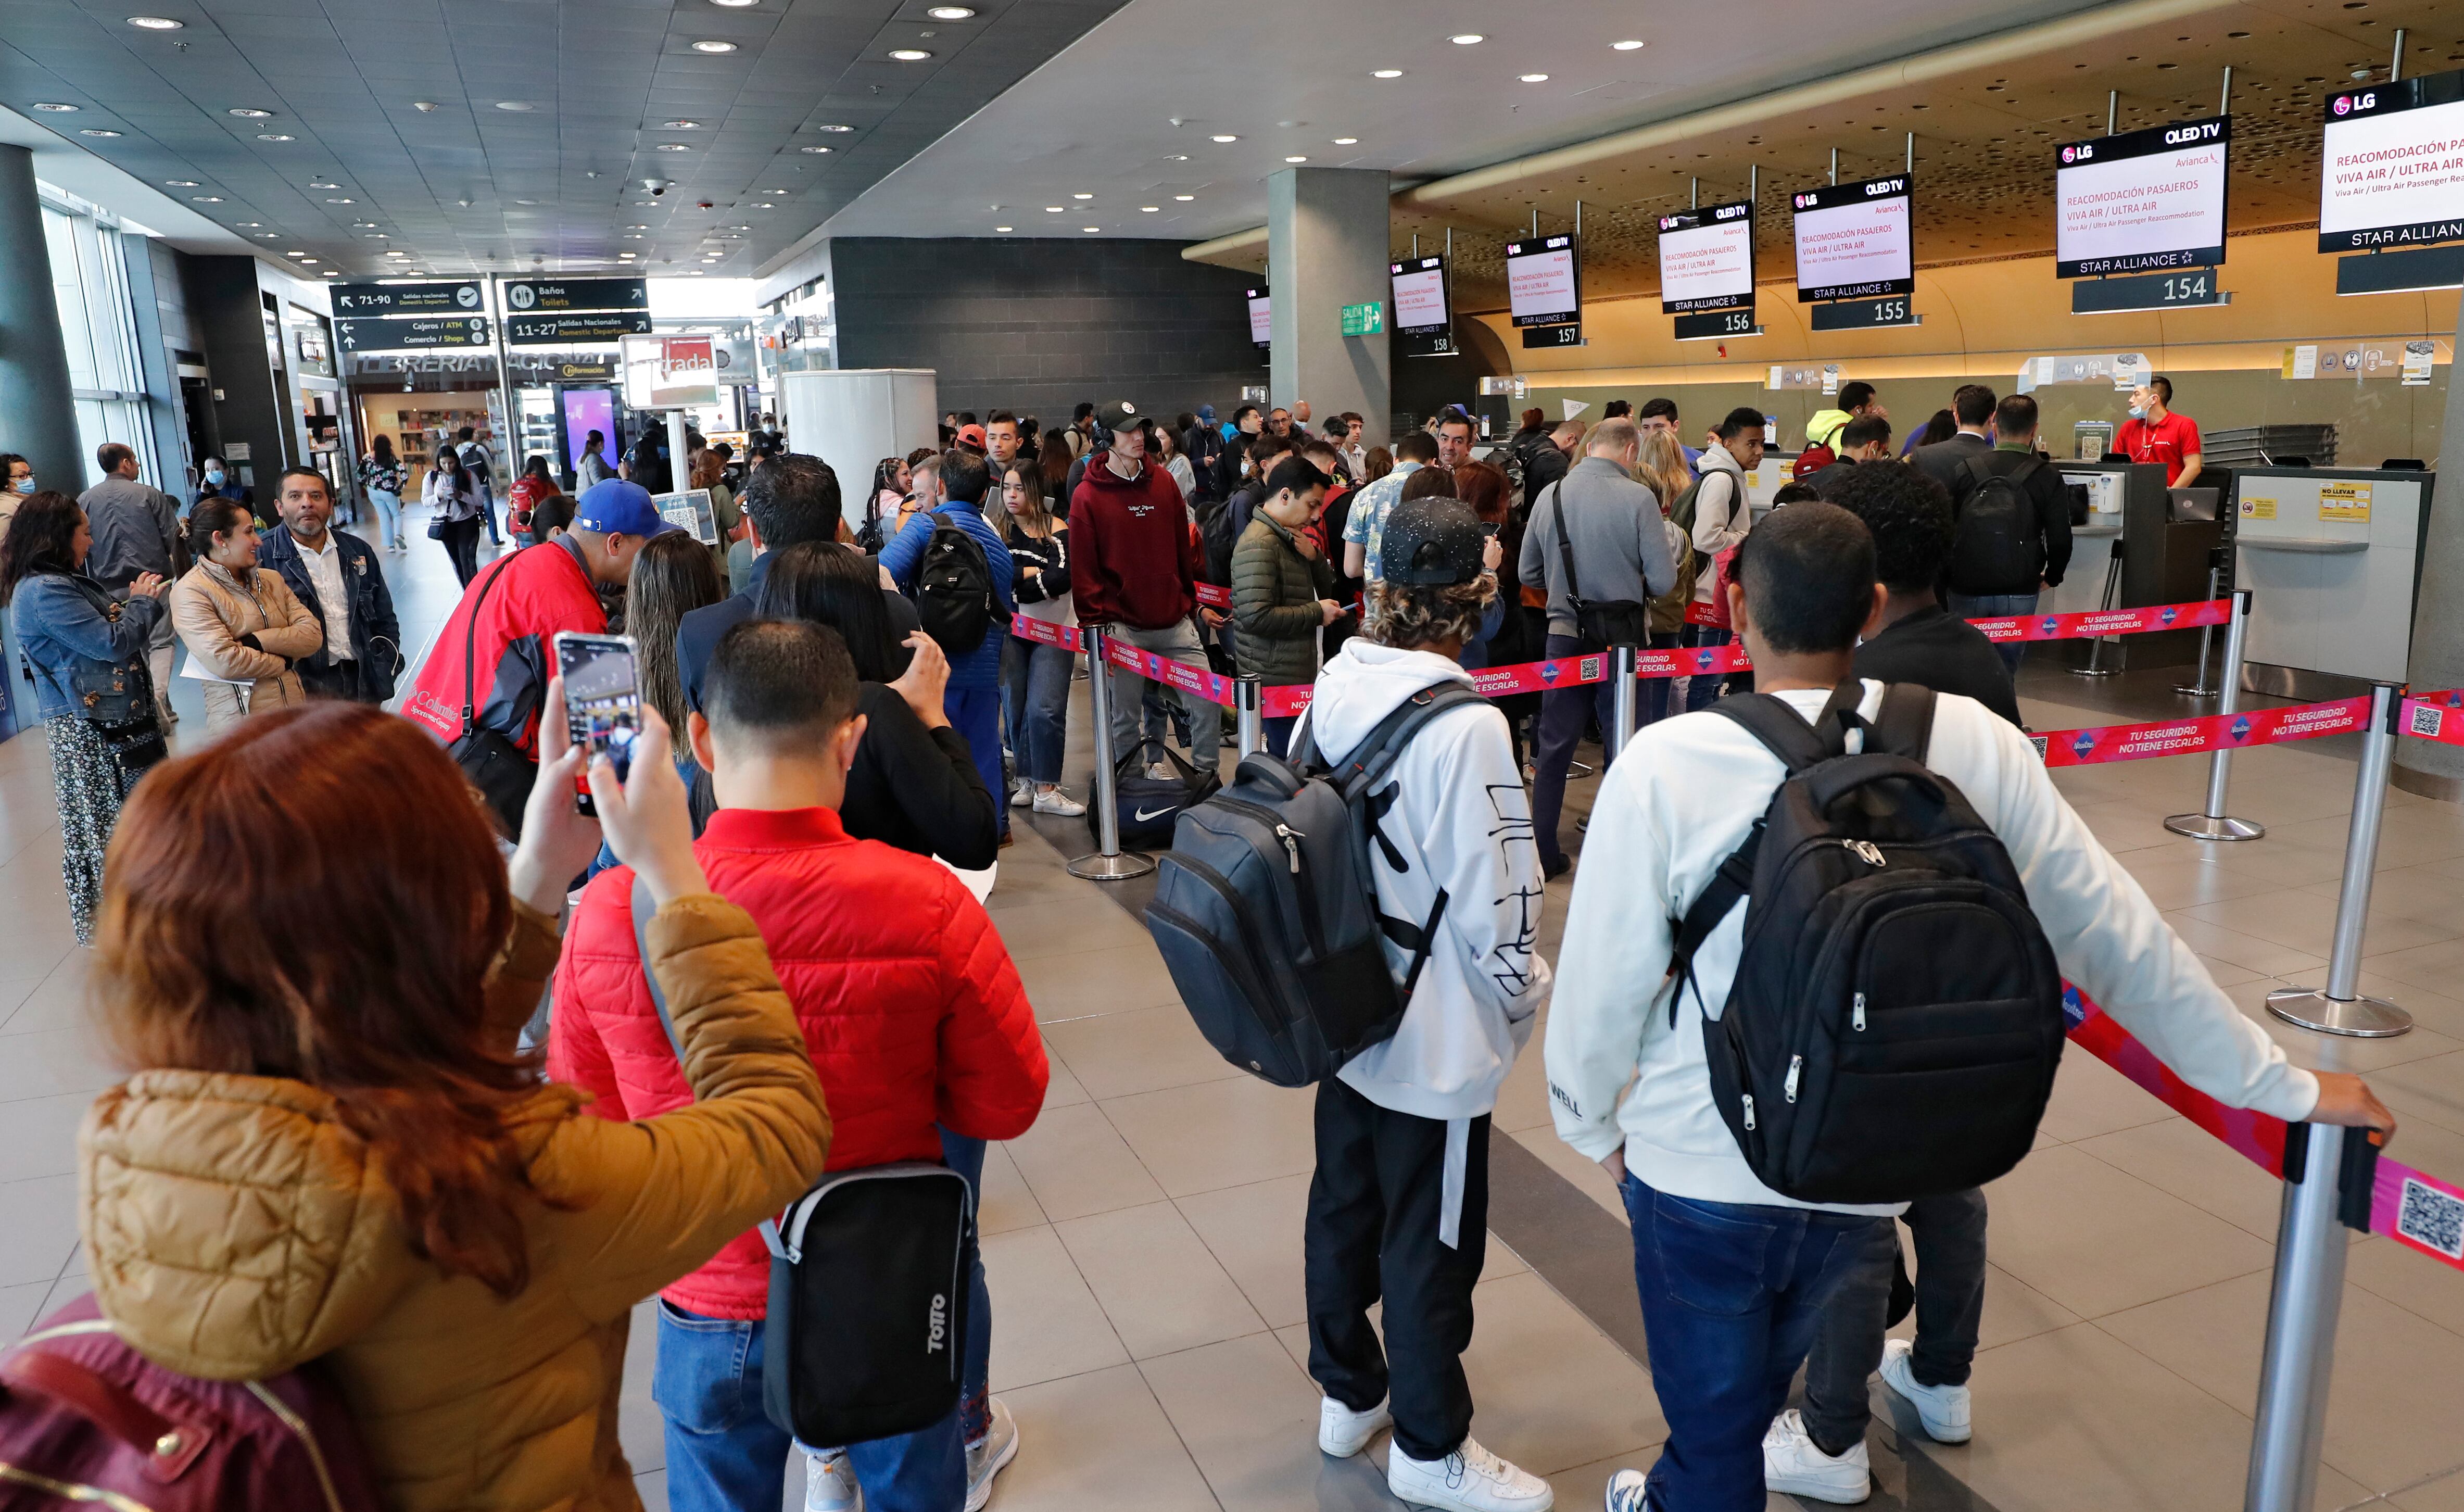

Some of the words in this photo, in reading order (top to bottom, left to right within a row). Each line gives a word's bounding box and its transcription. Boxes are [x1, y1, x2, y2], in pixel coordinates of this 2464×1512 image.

[2354, 93, 2375, 110] LG
[2166, 127, 2200, 144] OLED
[2202, 123, 2220, 137] TV
[2077, 145, 2093, 160] LG
[2337, 140, 2446, 167] REACOMODACIÓN
[2450, 138, 2464, 150] PA
[2176, 155, 2208, 168] Avianca
[2336, 172, 2363, 183] VIVA
[2366, 168, 2386, 180] AIR
[2399, 161, 2438, 176] ULTRA
[2442, 158, 2463, 169] AIR
[1866, 182, 1890, 195] OLED
[1890, 179, 1903, 192] TV
[2372, 184, 2391, 193] Ultra
[2407, 177, 2448, 188] Passenger
[1805, 194, 1817, 206] LG
[2068, 186, 2144, 206] REACOMODACIÓN
[2147, 180, 2198, 195] PASAJEROS
[1716, 207, 1735, 219] OLED
[1735, 205, 1746, 215] TV
[1875, 205, 1898, 215] Avianca
[2067, 210, 2087, 221] VIVA
[2089, 208, 2102, 219] AIR
[2112, 205, 2139, 215] ULTRA
[2142, 201, 2156, 211] AIR
[1668, 217, 1678, 227] LG
[2118, 217, 2146, 226] Passenger
[2148, 210, 2204, 222] Reaccommodation
[1802, 229, 1855, 244] REACOMODACIÓN
[1857, 224, 1892, 237] PASAJEROS
[2352, 230, 2394, 246] STAR
[2399, 222, 2463, 241] ALLIAN
[1513, 245, 1521, 254] LG
[1547, 238, 1561, 248] OLED
[1802, 247, 1816, 255] VIVA
[1834, 243, 1852, 252] ULTRA
[1854, 241, 1865, 249] AIR
[1666, 249, 1708, 260] REACOMODACIÓN
[1709, 245, 1737, 256] PASAJEROS
[2080, 260, 2111, 273] STAR
[2114, 254, 2177, 270] ALLIANCE
[1815, 288, 1835, 298] STAR
[1838, 284, 1881, 296] ALLIANCE
[2165, 277, 2206, 300] 154
[359, 295, 390, 305] 71-90
[1675, 301, 1692, 310] STAR
[1694, 298, 1728, 309] ALLIANCE
[1343, 307, 1362, 319] SALIDA
[1536, 314, 1560, 323] ALLIANCE
[1875, 301, 1903, 321] 155
[413, 323, 438, 332] Cajeros
[516, 323, 557, 336] 11-27
[1725, 314, 1749, 331] 156
[1559, 328, 1575, 342] 157
[1434, 338, 1447, 351] 158
[485, 353, 604, 373] NACIONA
[2095, 613, 2136, 622] SEGURIDAD
[2089, 623, 2109, 631] TIENE
[2111, 621, 2142, 629] ESCALAS
[1636, 655, 1669, 663] GURIDAD
[1176, 667, 1198, 679] SEGURIDAD
[1472, 672, 1511, 683] GURIDAD
[1173, 675, 1184, 685] TIENE
[1185, 679, 1202, 690] ESCALAS
[1482, 680, 1519, 692] ESCALAS
[417, 691, 458, 723] Columbia
[2283, 714, 2296, 723] TU
[2297, 707, 2347, 722] SEGURIDAD
[2130, 732, 2143, 741] TU
[2144, 726, 2197, 740] SEGURIDAD
[2272, 727, 2288, 736] NO
[2289, 723, 2315, 734] TIENE
[2315, 717, 2353, 730] ESCALAS
[2119, 744, 2134, 753] NO
[2136, 740, 2163, 753] TIENE
[2164, 736, 2205, 749] ESCALAS
[2063, 998, 2084, 1020] osotras
[1550, 1079, 1583, 1118] WELL
[928, 1293, 945, 1354] TOTTO
